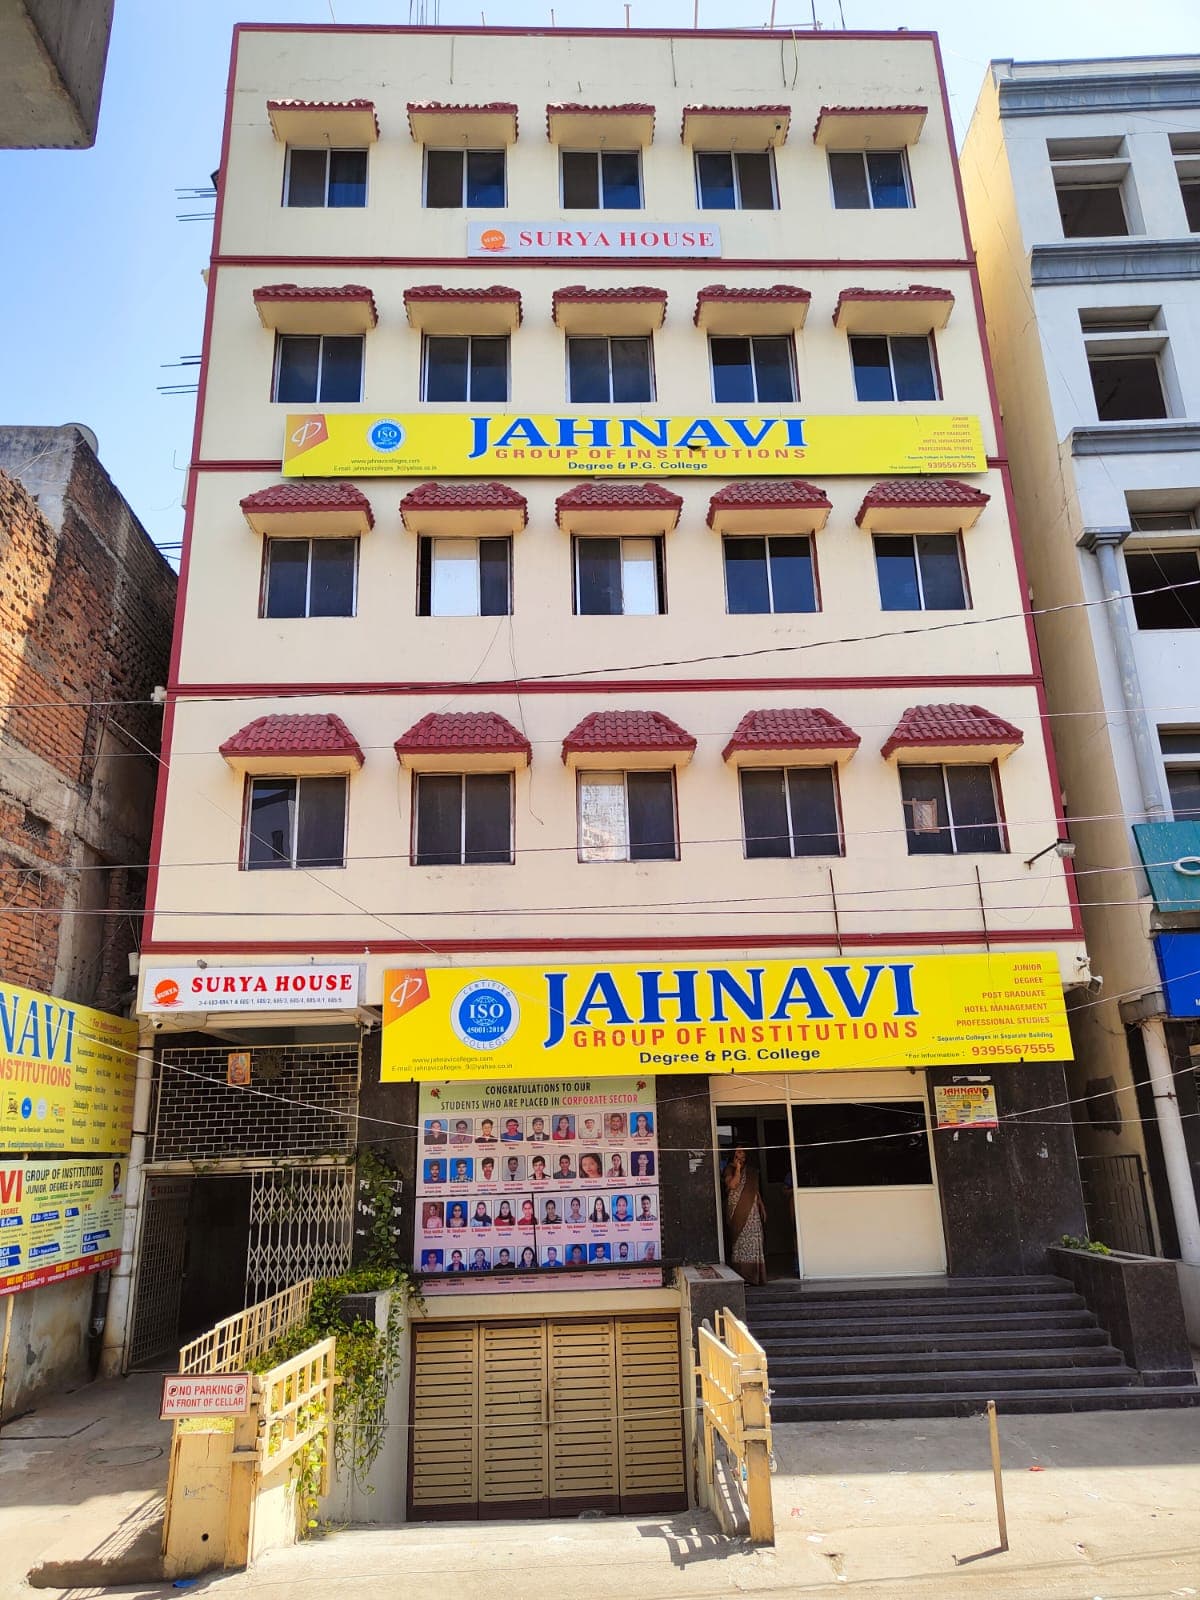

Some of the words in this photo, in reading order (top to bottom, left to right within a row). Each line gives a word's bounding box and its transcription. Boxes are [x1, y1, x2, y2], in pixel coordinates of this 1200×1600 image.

[519, 231, 610, 247] SURYA
[620, 231, 714, 248] HOUSE
[377, 430, 397, 438] ISO
[468, 417, 808, 459] JAHNAVI
[496, 449, 578, 459] GROUP
[597, 449, 616, 459] OF
[627, 449, 806, 459] INSTITUTIONS
[568, 461, 614, 472] Degree
[618, 461, 626, 470] &
[630, 461, 656, 470] P.G.
[660, 461, 708, 471] College
[192, 976, 267, 993] SURYA
[274, 974, 352, 992] HOUSE
[1014, 976, 1044, 984] DEGREE
[463, 982, 511, 998] CERTIFIED
[982, 991, 1002, 999] POST
[1004, 990, 1046, 998] GRADUATE
[470, 1004, 504, 1019] ISO
[543, 964, 920, 1048] JAHNAVI
[964, 1005, 988, 1013] HOTEL
[990, 1003, 1048, 1012] MANAGEMENT
[956, 1018, 1015, 1026] PROFESSIONAL
[1017, 1016, 1050, 1024] STUDIES
[574, 1028, 666, 1048] GROUP
[676, 1027, 708, 1045] OF
[719, 1021, 918, 1044] INSTITUTIONS
[463, 1036, 508, 1049] COLLEGE
[640, 1052, 698, 1064] Degree
[704, 1050, 716, 1062] &
[722, 1050, 750, 1062] P.G.
[757, 1048, 820, 1061] College
[972, 1044, 1056, 1056] 9395567555
[486, 1083, 560, 1095] CONGRATULATIONS
[562, 1082, 572, 1092] TO
[574, 1082, 591, 1092] OUR
[944, 1088, 982, 1096] JAHNAVI
[441, 1100, 480, 1110] STUDENTS
[482, 1098, 500, 1109] WHO
[504, 1098, 518, 1108] ARE
[520, 1096, 548, 1108] PLACED
[552, 1096, 560, 1106] IN
[562, 1095, 607, 1106] CORPORATE
[610, 1094, 638, 1104] SECTOR
[26, 1169, 50, 1182] GROUP
[52, 1168, 60, 1180] OF
[62, 1166, 104, 1179] INSTITUTIONS
[26, 1184, 47, 1194] JUNIOR
[49, 1182, 68, 1192] DEGREE
[74, 1181, 80, 1189] PG
[82, 1178, 102, 1188] COLLEGES
[180, 1385, 192, 1396] NO
[194, 1384, 233, 1395] PARKING
[166, 1399, 174, 1408] IN
[176, 1398, 200, 1407] FRONT
[203, 1398, 213, 1406] OF
[215, 1398, 244, 1406] CELLAR
